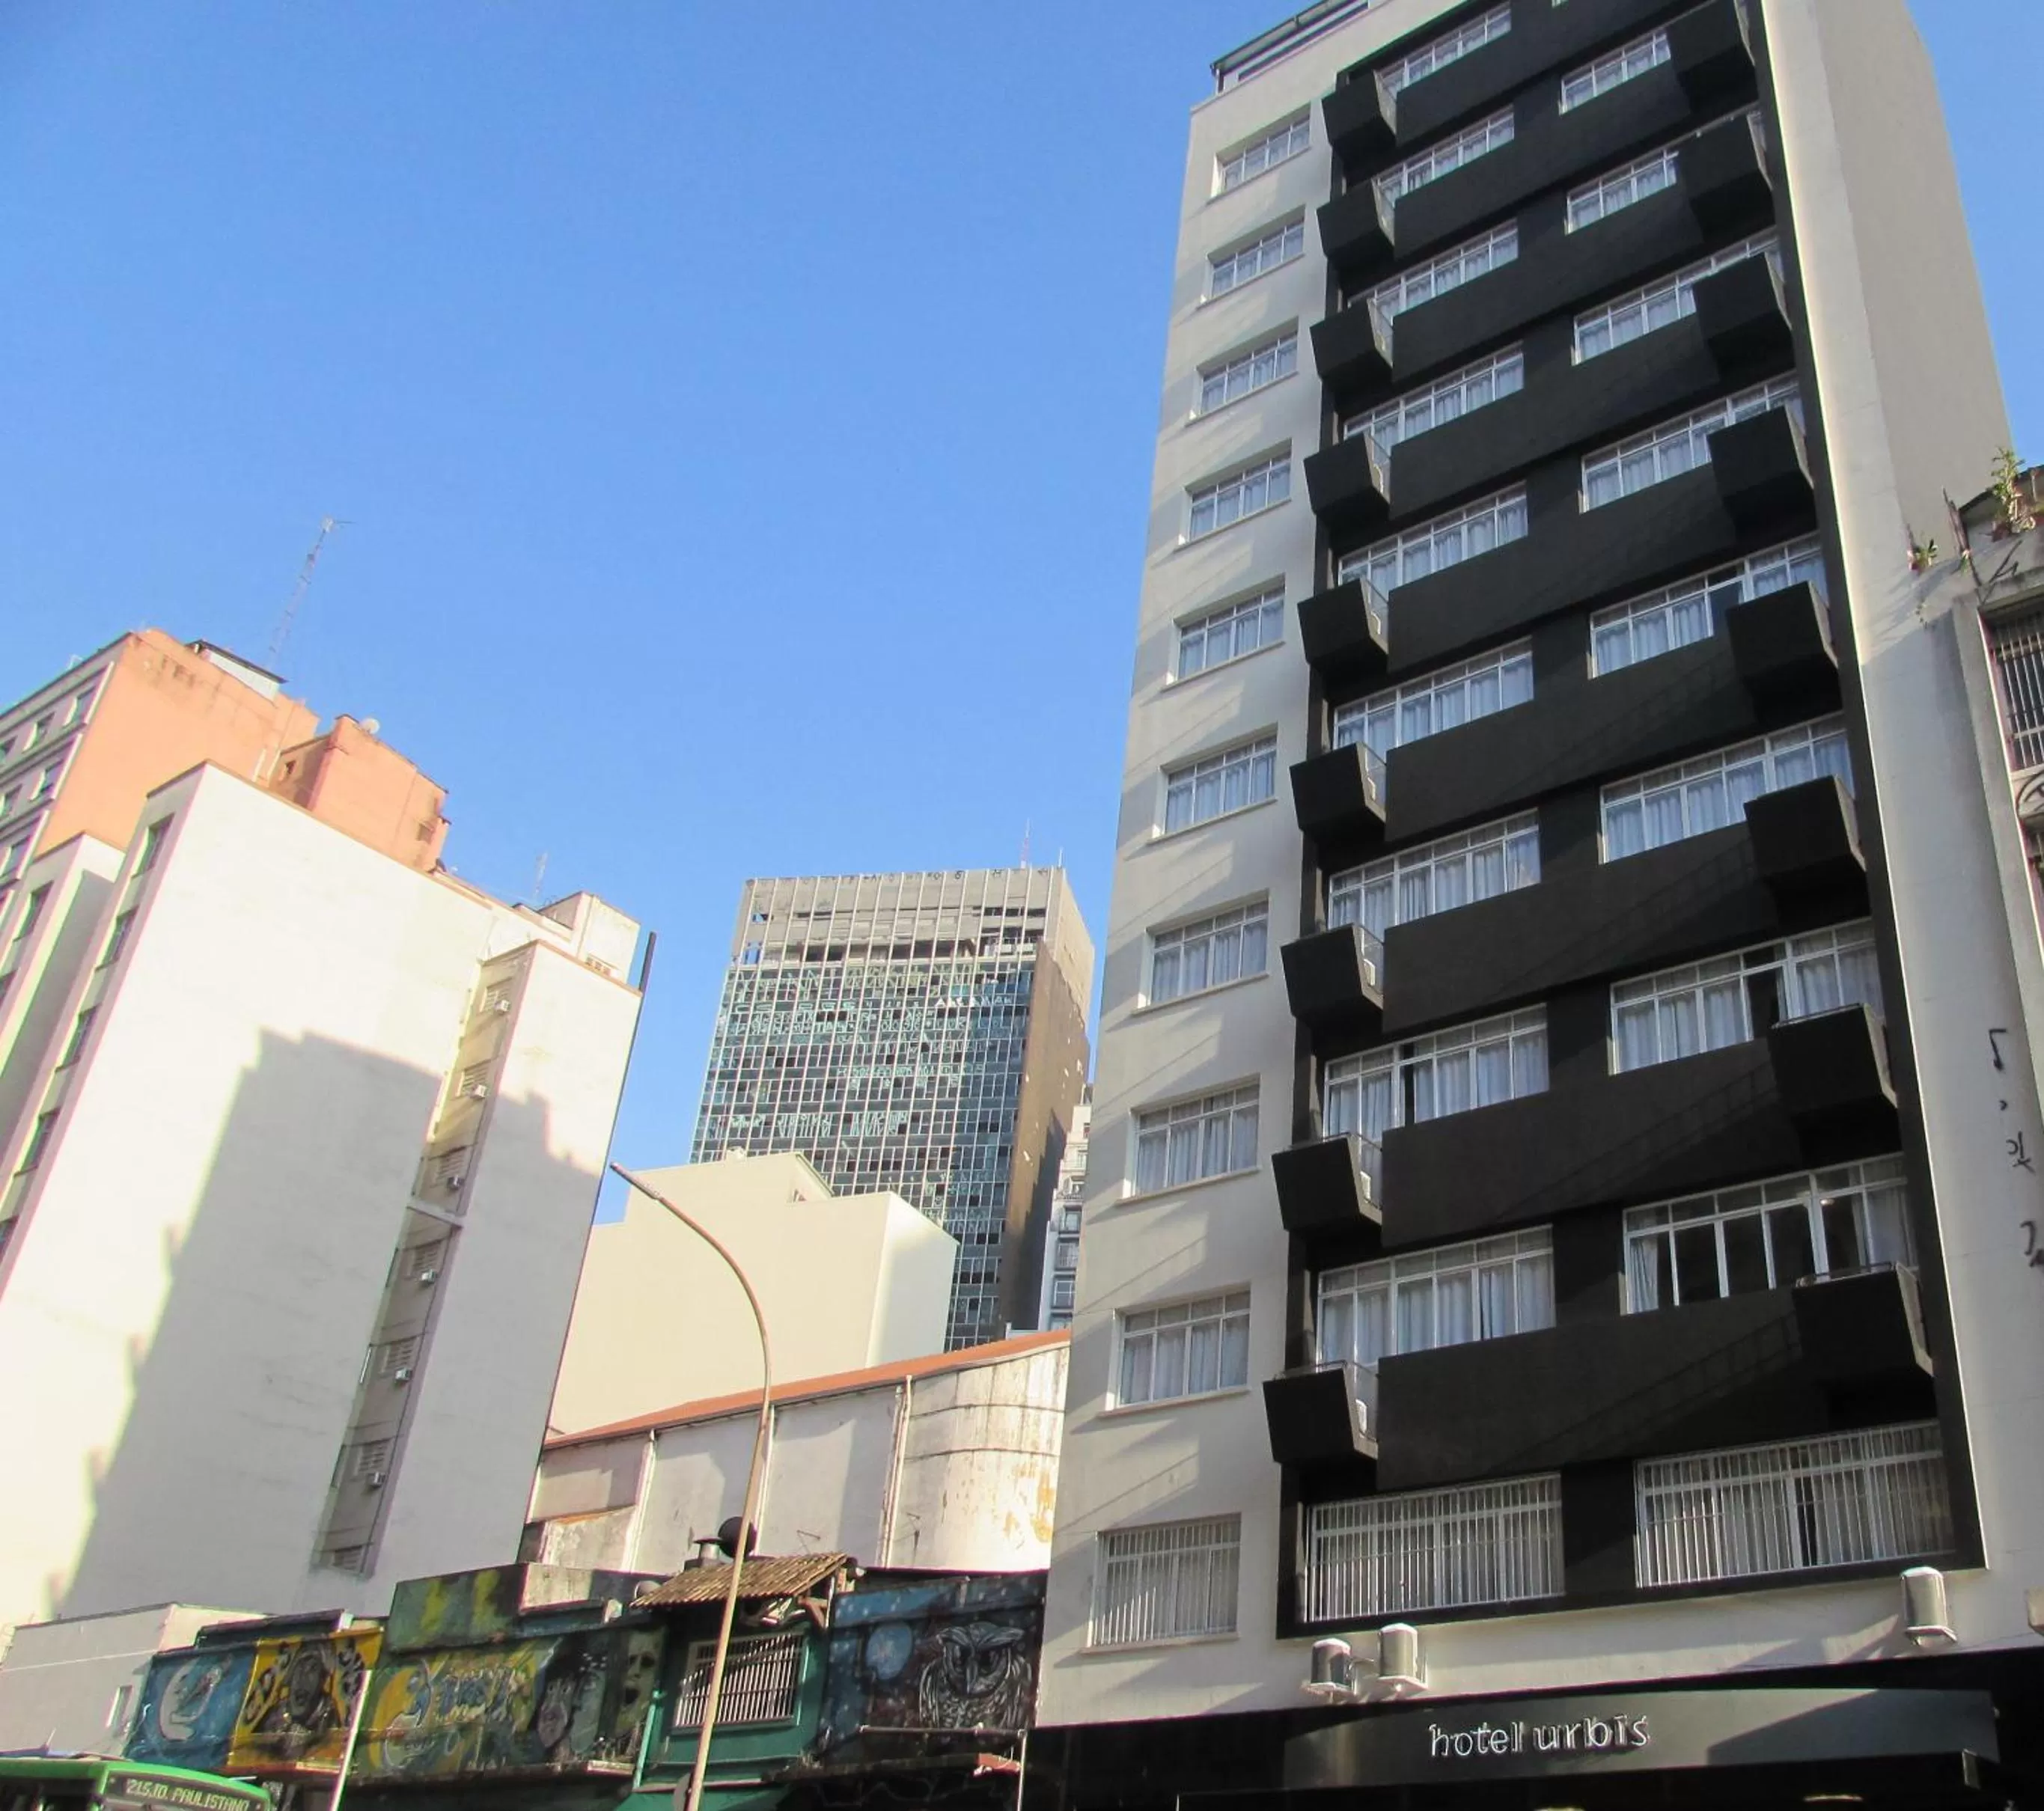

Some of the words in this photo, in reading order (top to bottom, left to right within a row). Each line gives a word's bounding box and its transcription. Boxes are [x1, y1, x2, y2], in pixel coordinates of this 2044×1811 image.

[1428, 1722, 1523, 1756] hotel
[1534, 1715, 1650, 1750] urbis
[171, 1787, 250, 1811] PAULISTANO
